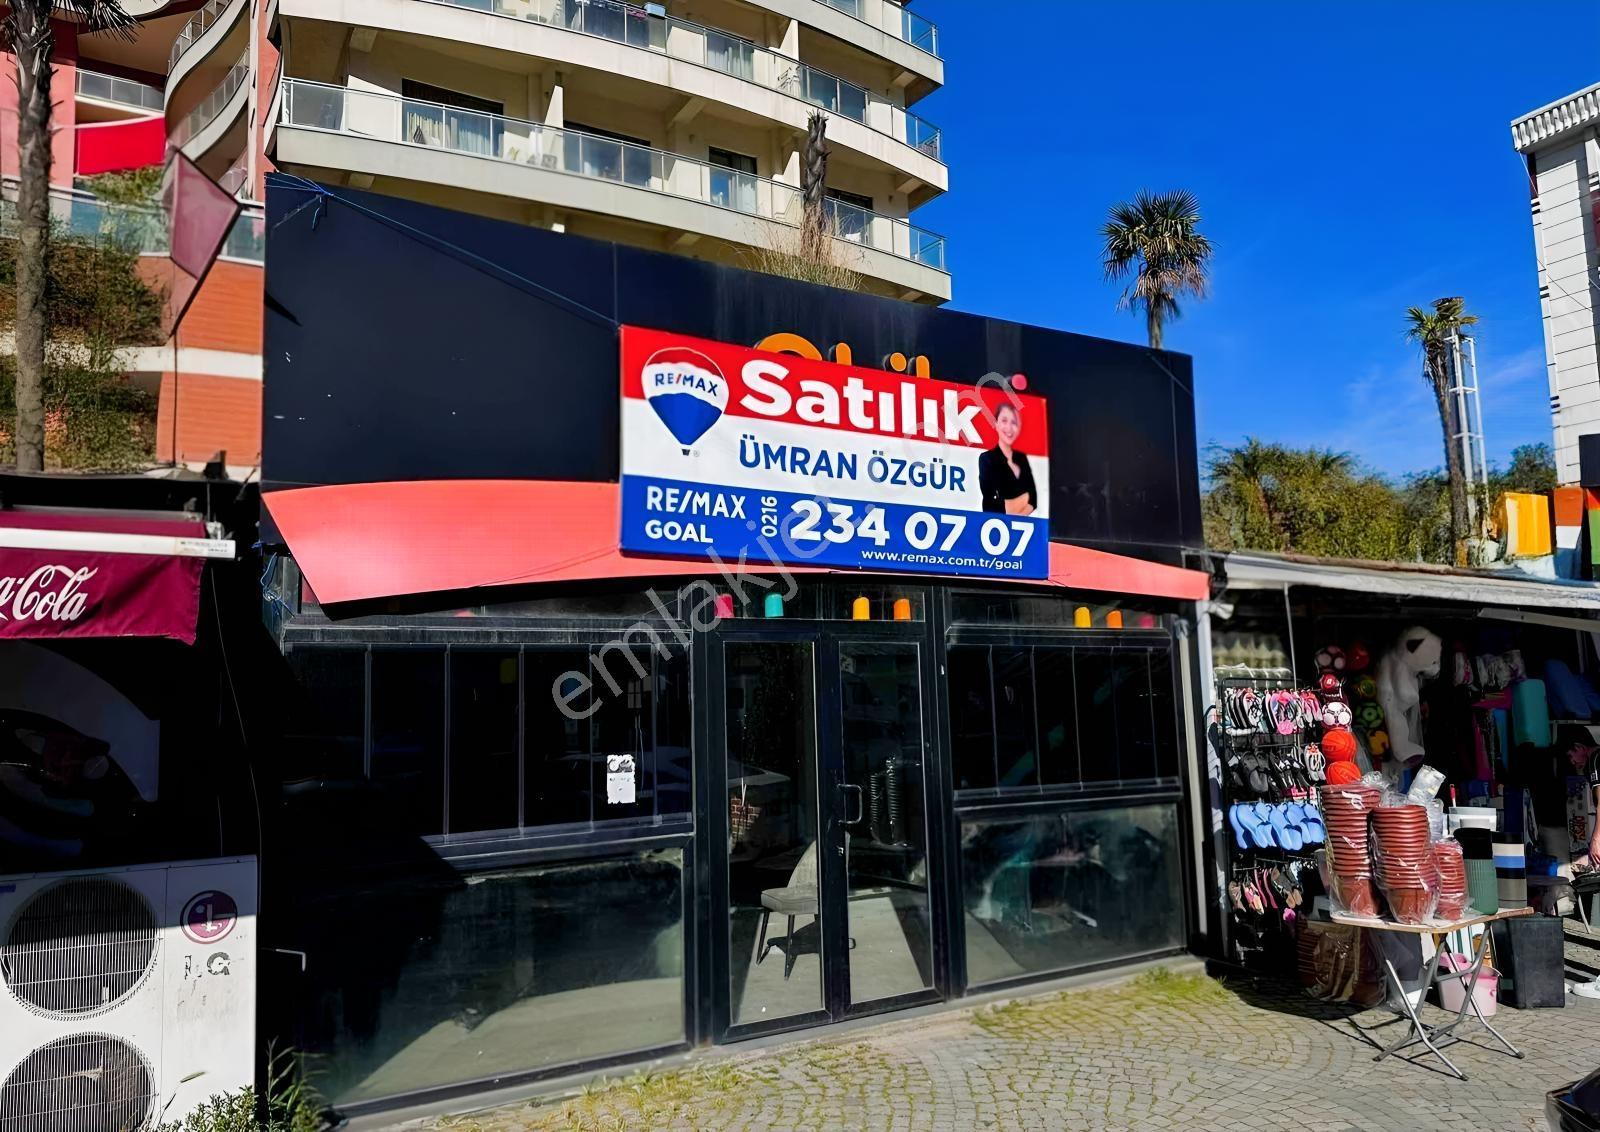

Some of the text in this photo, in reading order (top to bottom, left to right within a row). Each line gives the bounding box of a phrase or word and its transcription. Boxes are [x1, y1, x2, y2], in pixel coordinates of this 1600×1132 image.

[655, 372, 718, 397] RE/MAX
[739, 359, 983, 444] Satılık
[739, 434, 966, 492] ÜMRAN ÖZGÜR
[646, 486, 746, 519] RE/MAX
[760, 496, 777, 537] 0216
[645, 520, 713, 543] GOAL
[790, 499, 1035, 557] 234 07 07
[861, 549, 1023, 570] www.remax.com.tr/goal
